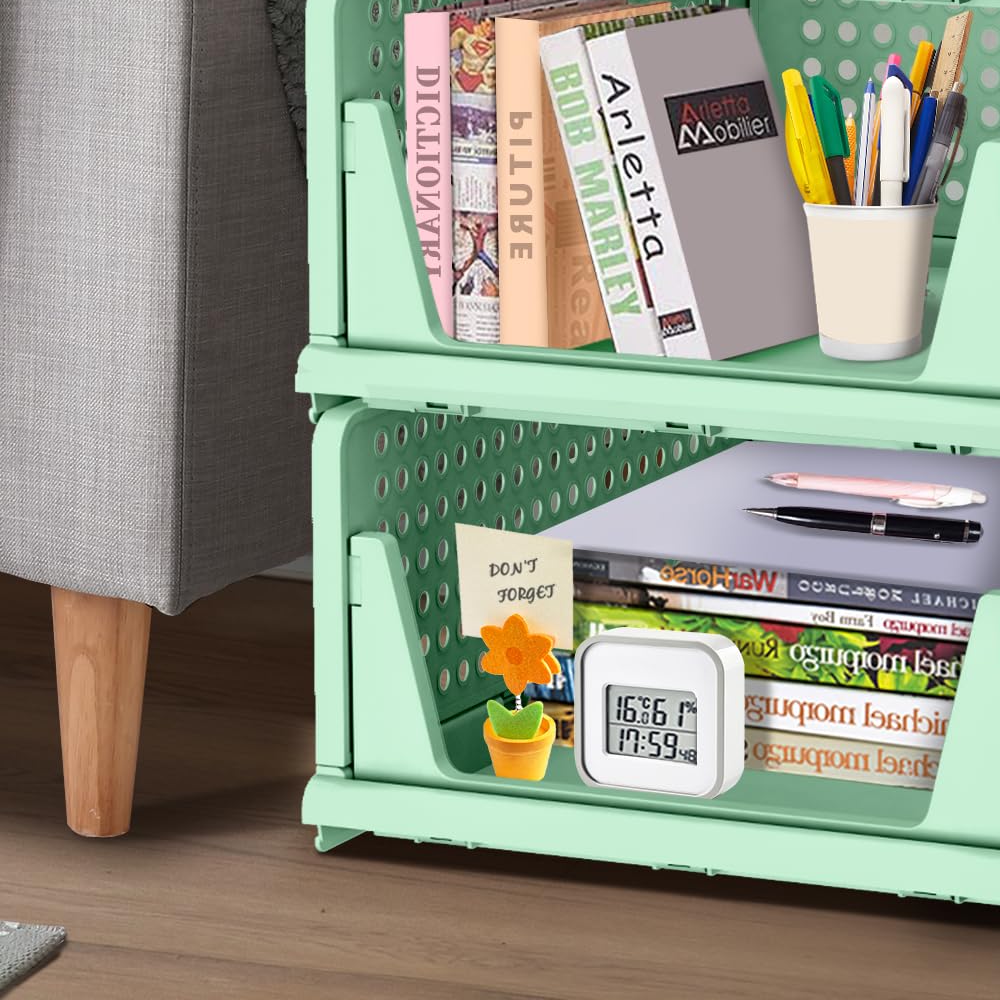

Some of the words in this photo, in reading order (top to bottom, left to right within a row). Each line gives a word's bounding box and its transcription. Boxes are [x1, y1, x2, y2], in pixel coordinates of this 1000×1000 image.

[678, 116, 771, 149] Mobilier
[601, 73, 664, 261] Arletta
[574, 159, 643, 317] MARLEY
[488, 557, 538, 578] DON'T
[617, 728, 678, 759] 17:59
